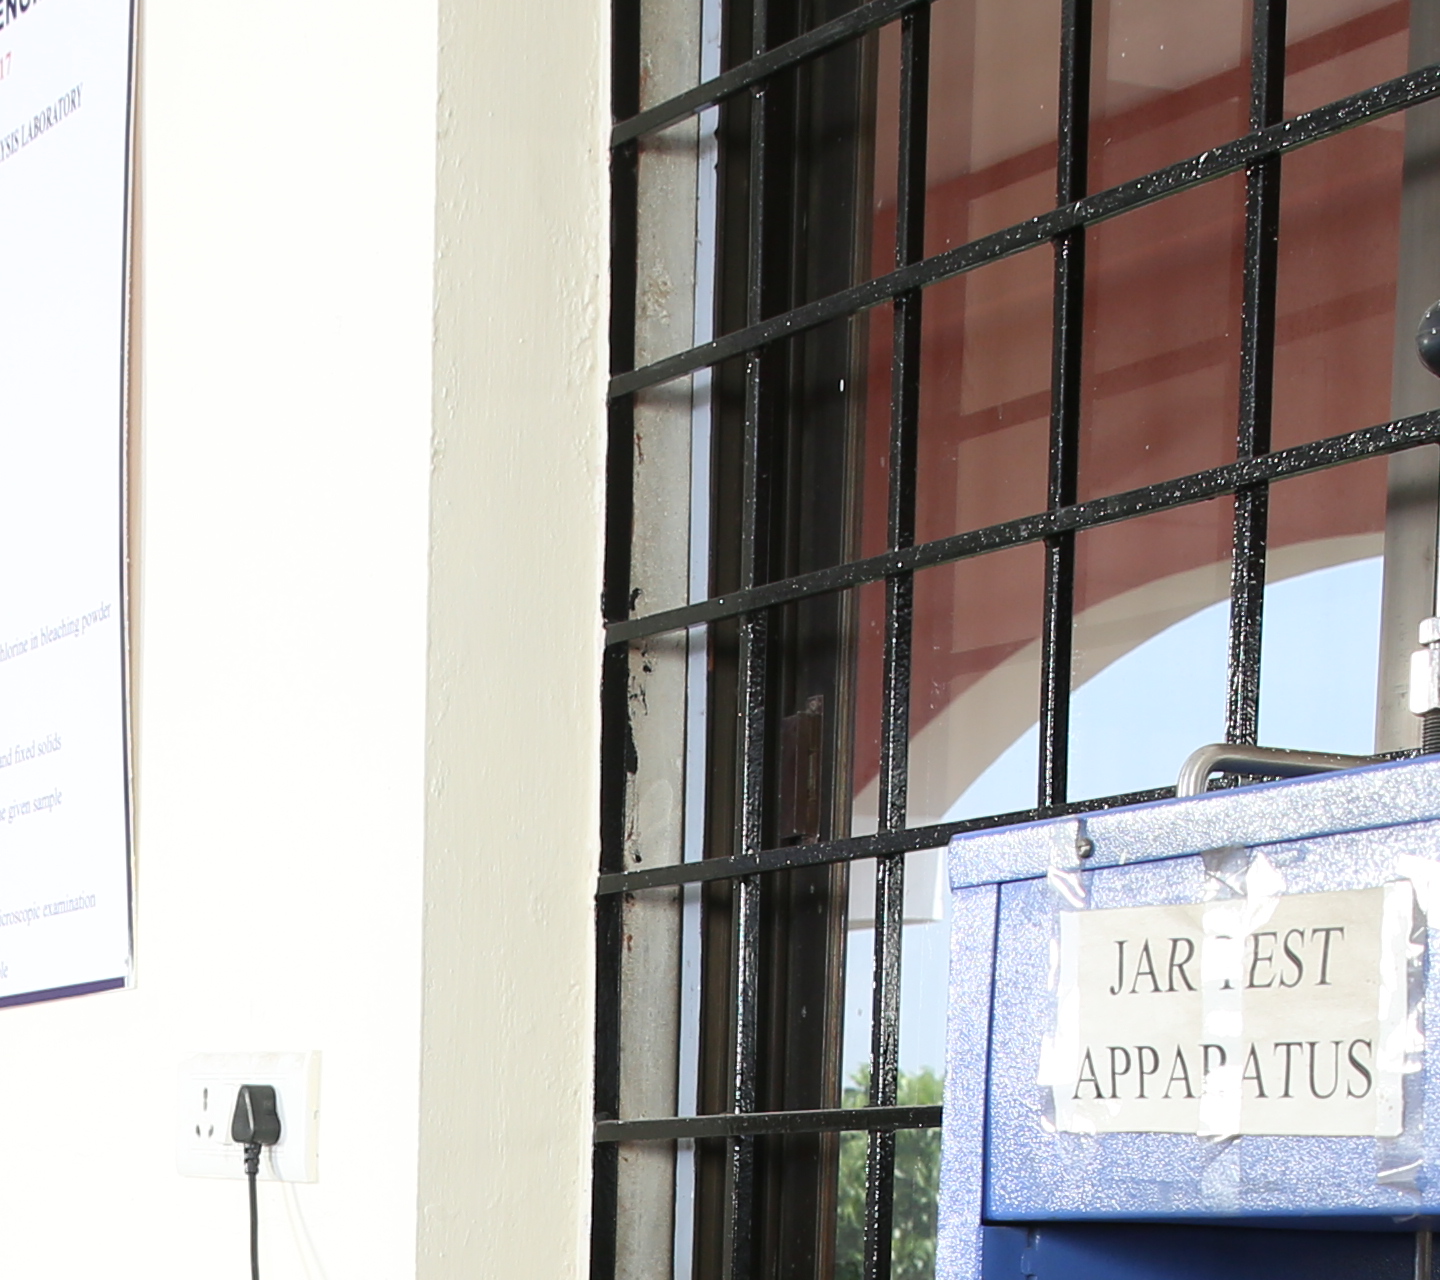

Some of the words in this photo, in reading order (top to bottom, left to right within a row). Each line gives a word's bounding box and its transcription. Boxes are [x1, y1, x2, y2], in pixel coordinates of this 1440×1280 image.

[21, 82, 82, 147] LABORATORY
[30, 630, 38, 651] in
[41, 612, 79, 650] bleaching
[81, 599, 110, 634] powder
[14, 739, 34, 764] fixed
[38, 731, 61, 757] solids
[8, 795, 30, 824] given
[33, 786, 62, 817] sample
[43, 887, 95, 918] examination
[1110, 937, 1197, 995] JAR
